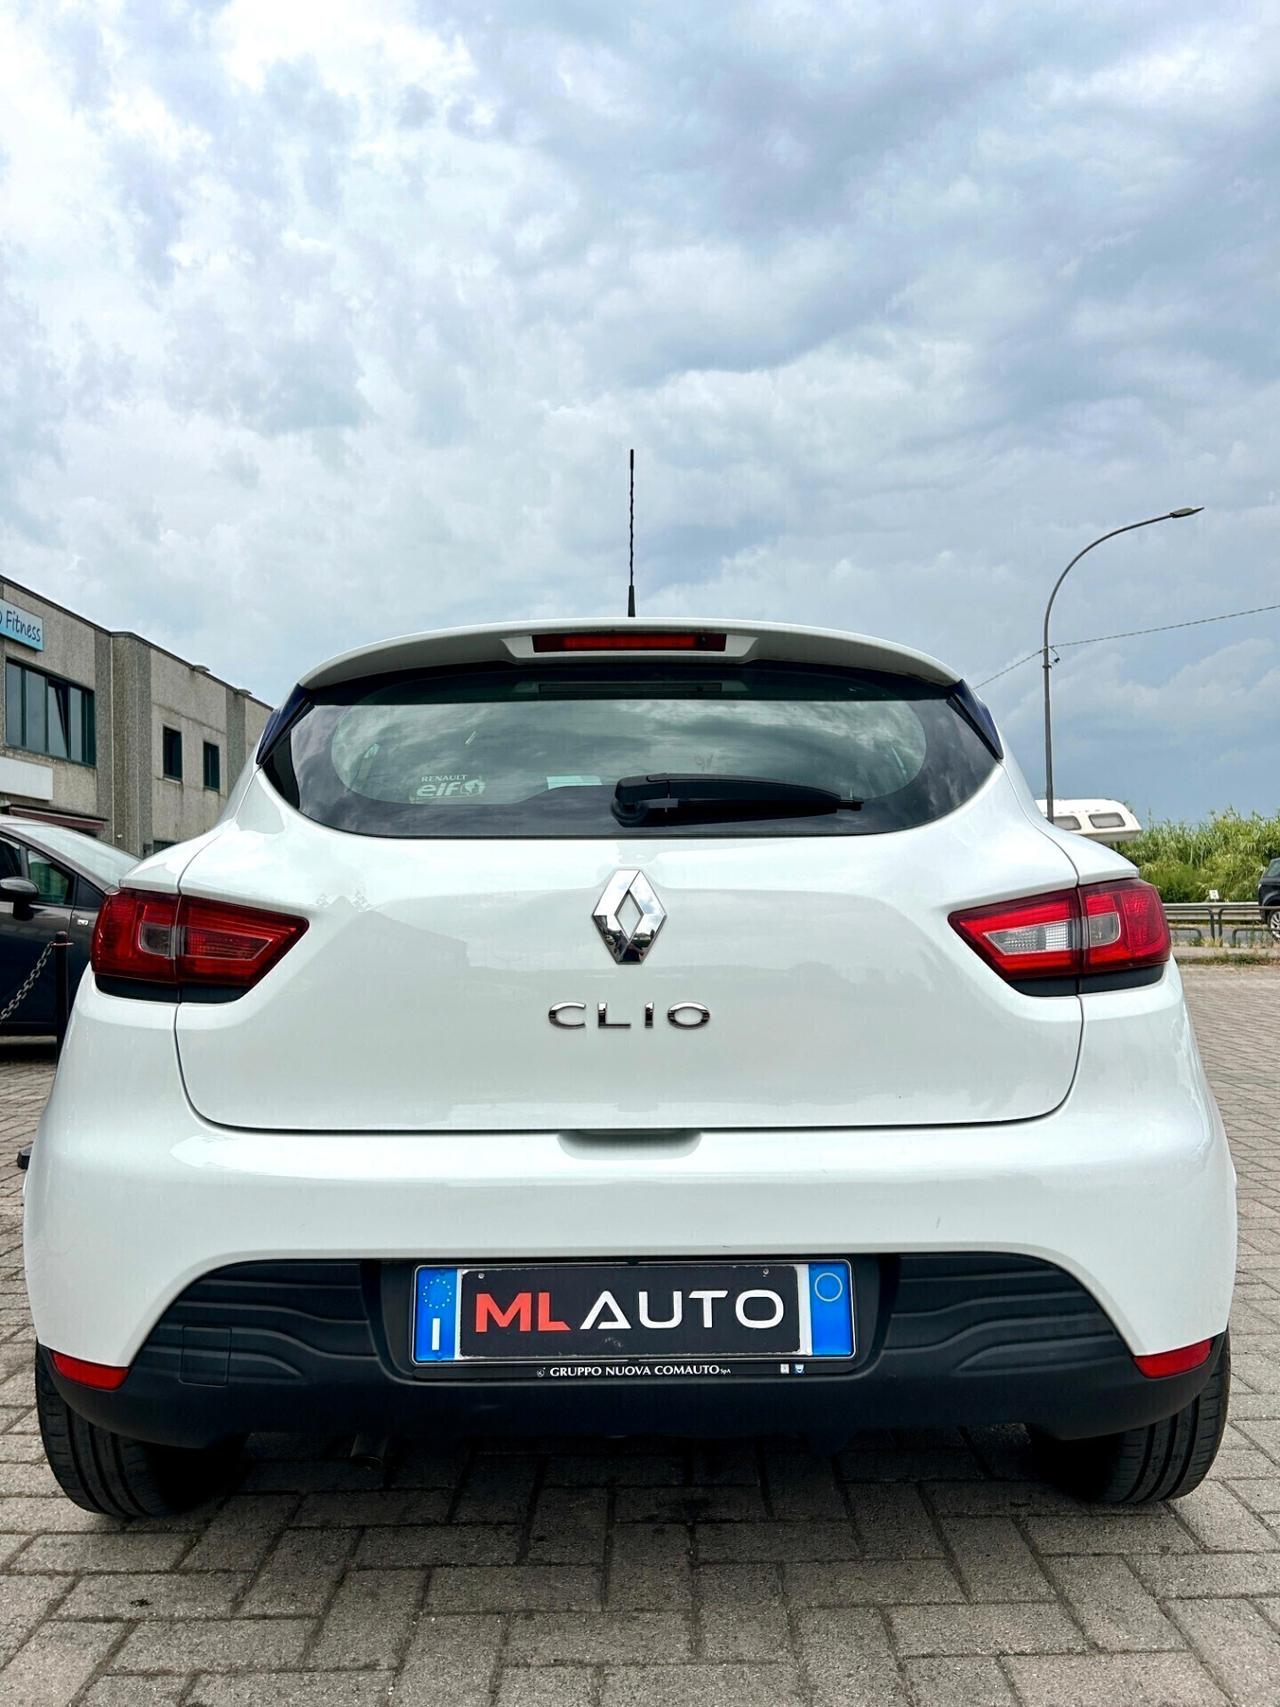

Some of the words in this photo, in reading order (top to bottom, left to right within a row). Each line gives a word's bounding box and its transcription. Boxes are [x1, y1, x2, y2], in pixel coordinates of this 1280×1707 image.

[6, 610, 41, 642] Fitness
[421, 774, 467, 783] RENAULT
[416, 781, 461, 797] elf
[548, 1002, 710, 1030] CLIO
[549, 1367, 602, 1377] GRUPPO
[605, 1366, 651, 1376] NUOVA
[654, 1365, 720, 1375] COMAUTO
